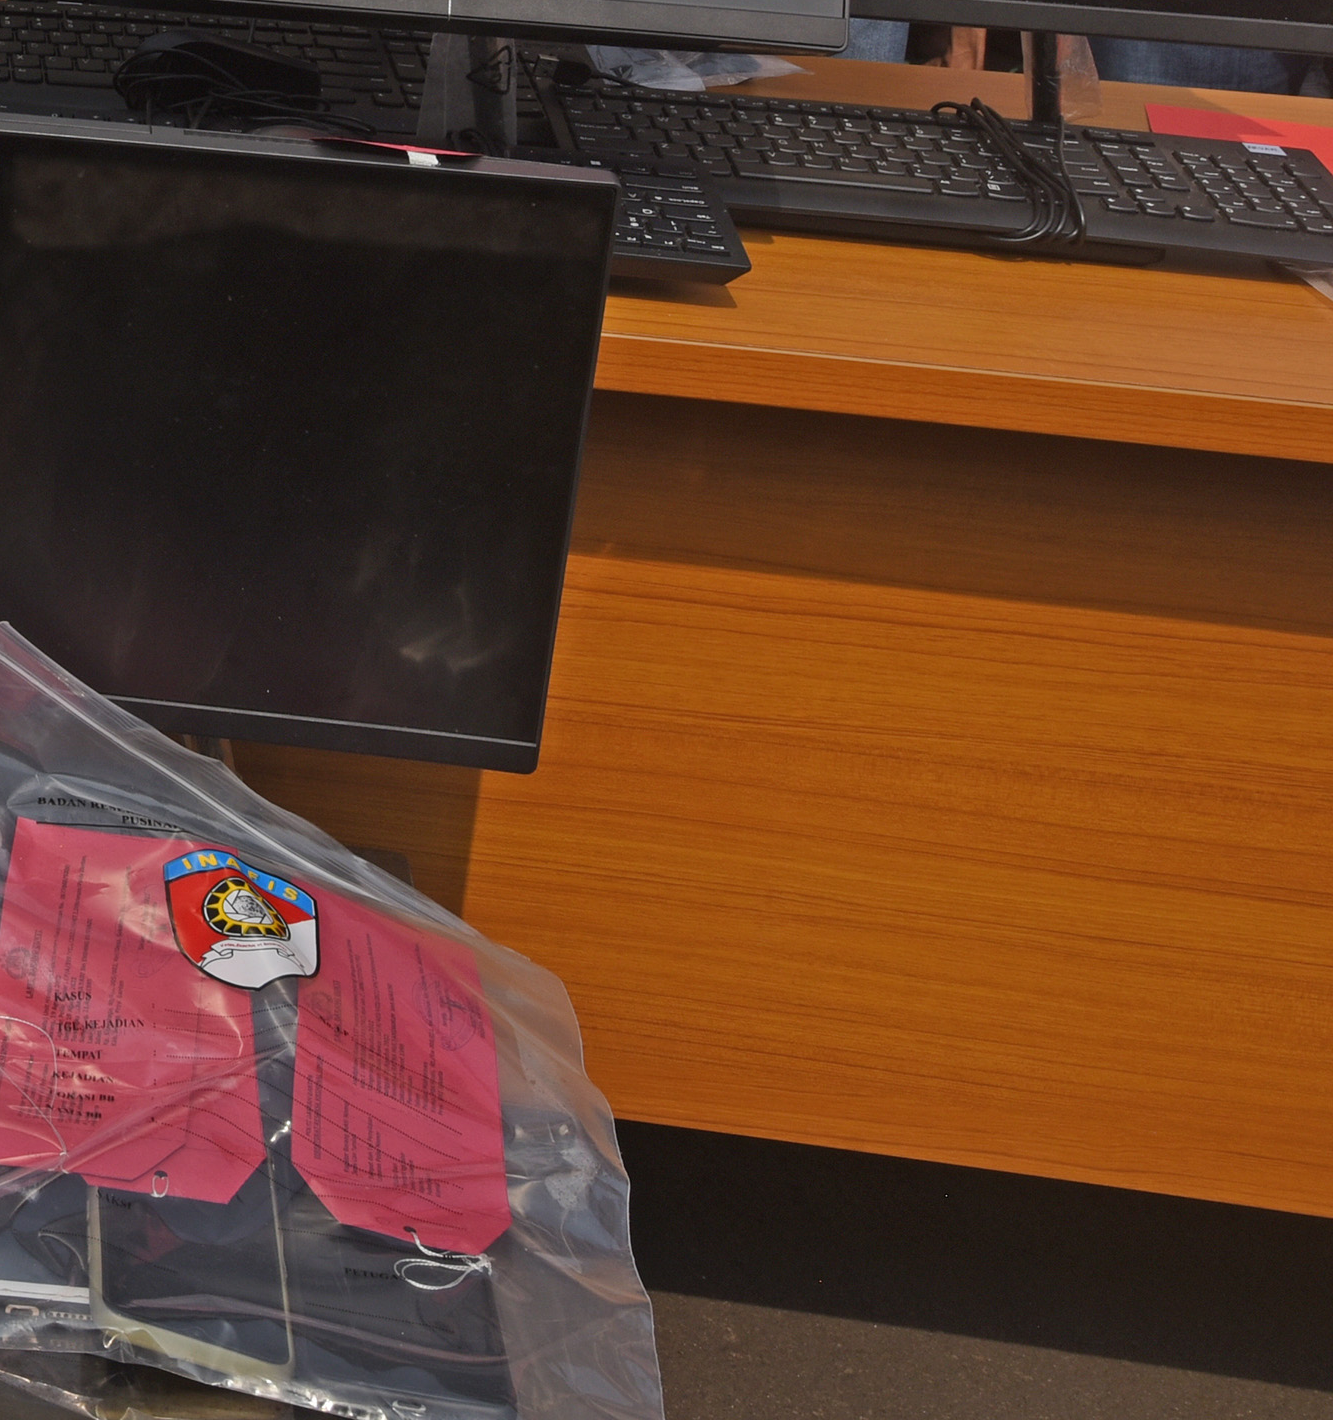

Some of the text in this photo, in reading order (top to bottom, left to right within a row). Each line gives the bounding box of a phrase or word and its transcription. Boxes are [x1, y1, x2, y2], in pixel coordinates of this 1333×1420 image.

[37, 797, 87, 808] BADAN
[182, 853, 298, 901] INAFIS
[54, 990, 92, 1002] KASUS
[85, 1018, 145, 1031] KEJADIAN
[55, 1049, 102, 1060] TEMPAT
[52, 1070, 114, 1084] KEJADIAN
[345, 1267, 400, 1281] PETUGA
